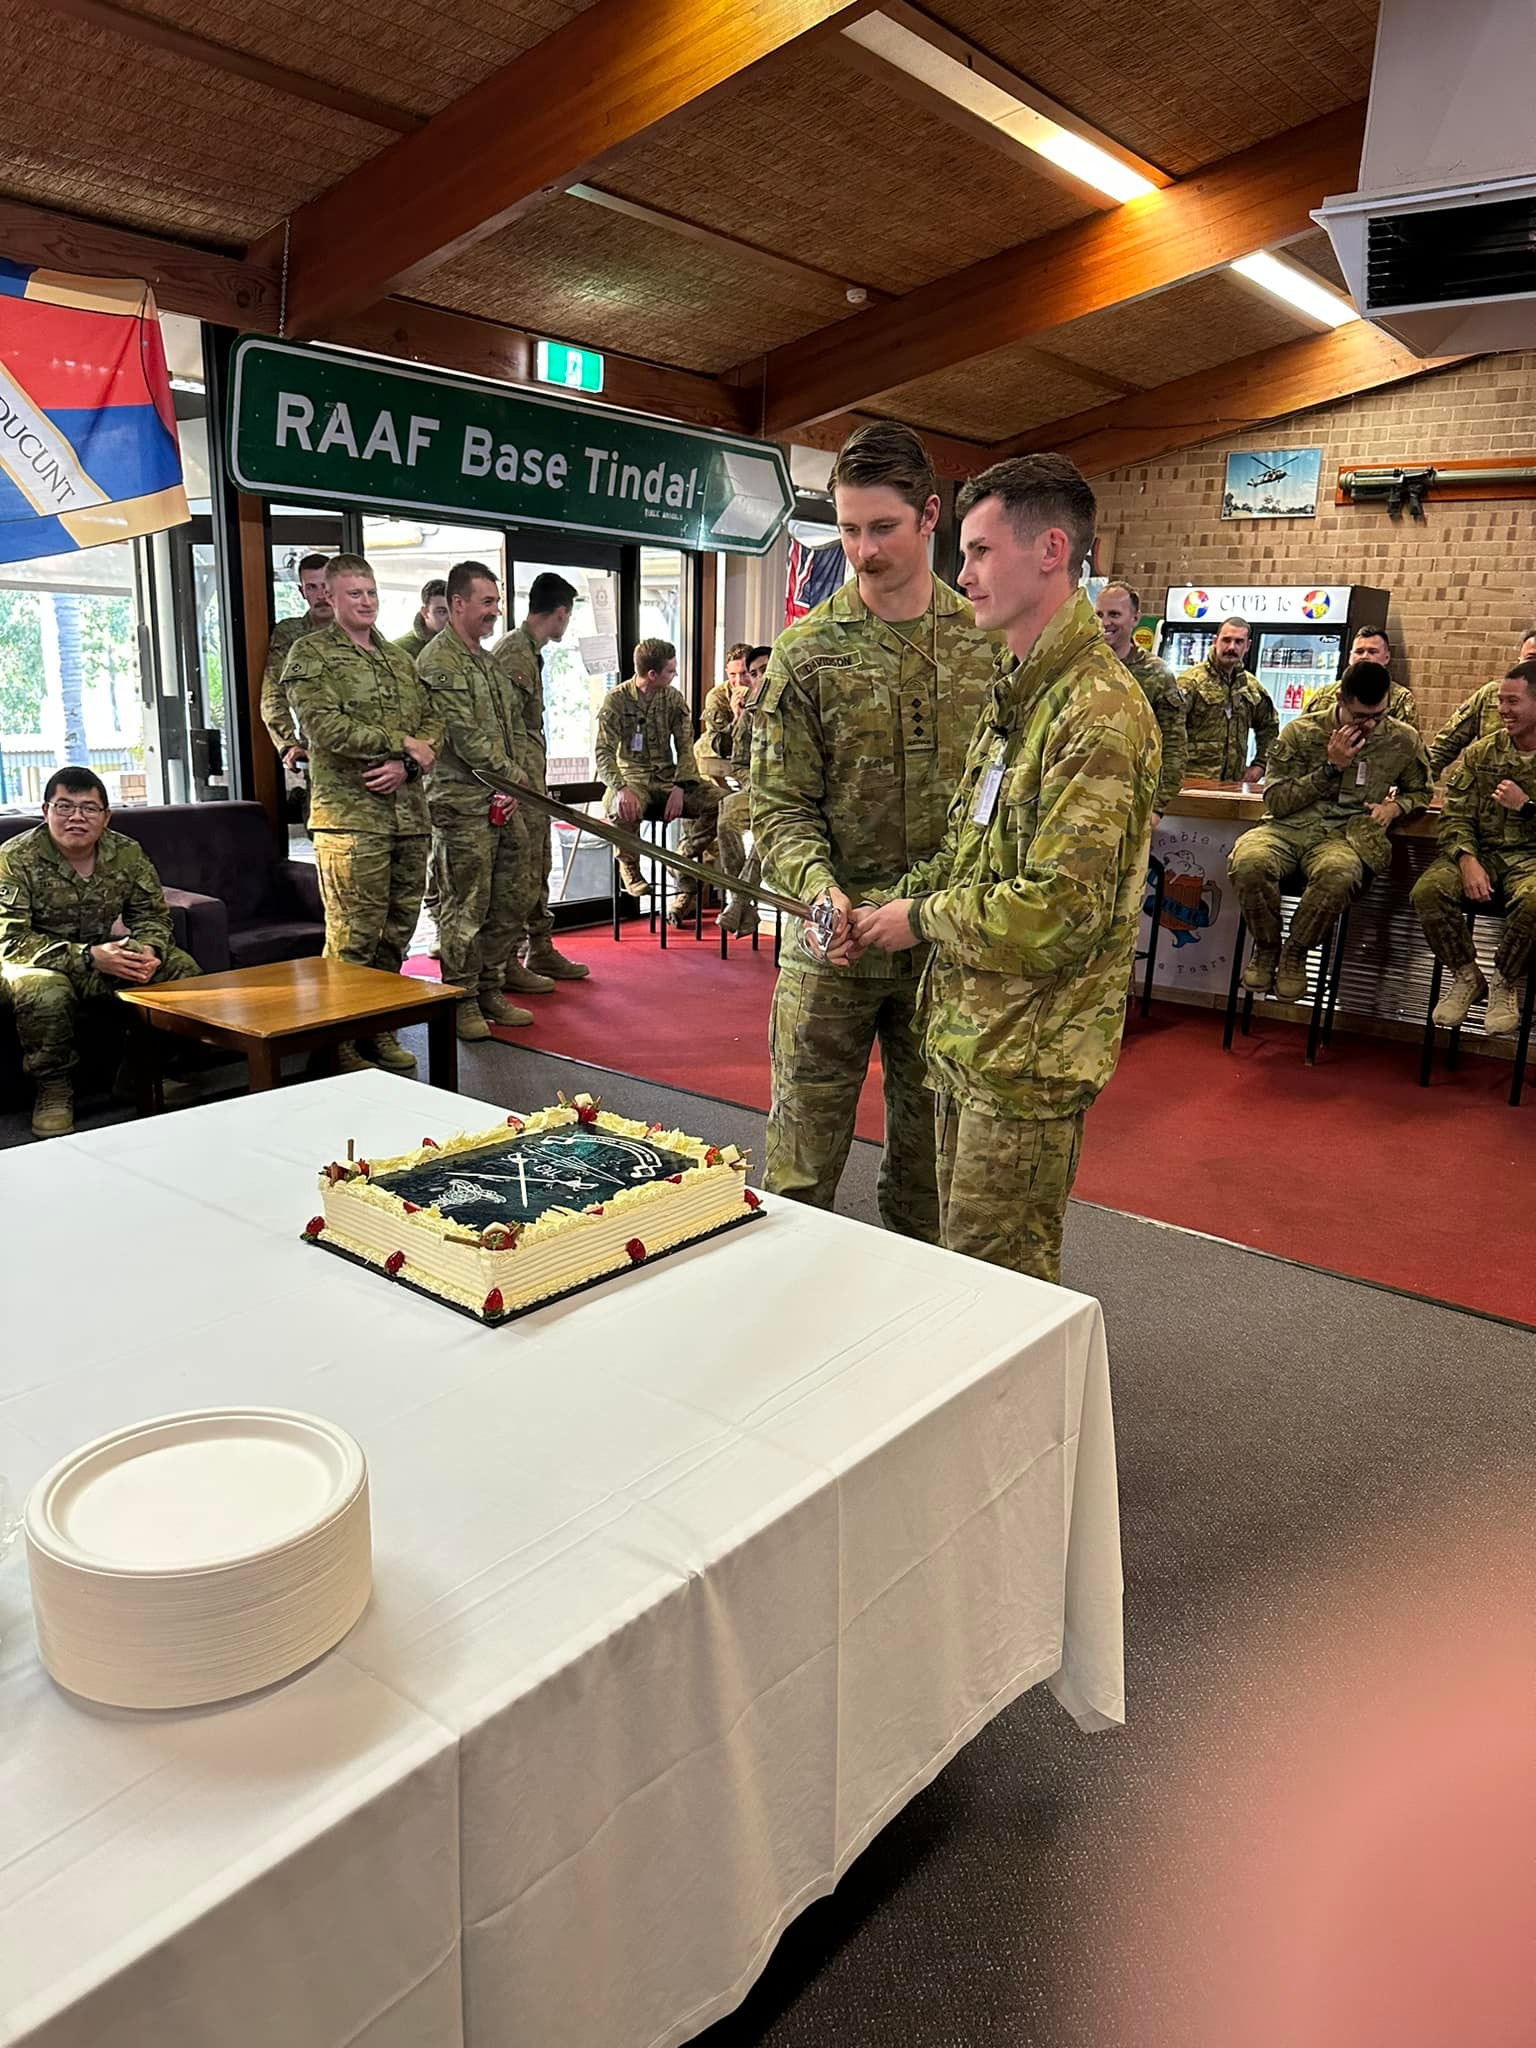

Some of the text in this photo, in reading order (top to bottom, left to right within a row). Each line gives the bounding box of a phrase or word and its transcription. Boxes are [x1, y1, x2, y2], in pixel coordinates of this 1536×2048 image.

[274, 391, 698, 509] RAAF Base Tindal
[1219, 594, 1268, 612] CLUB
[804, 655, 852, 674] DAVIDSON
